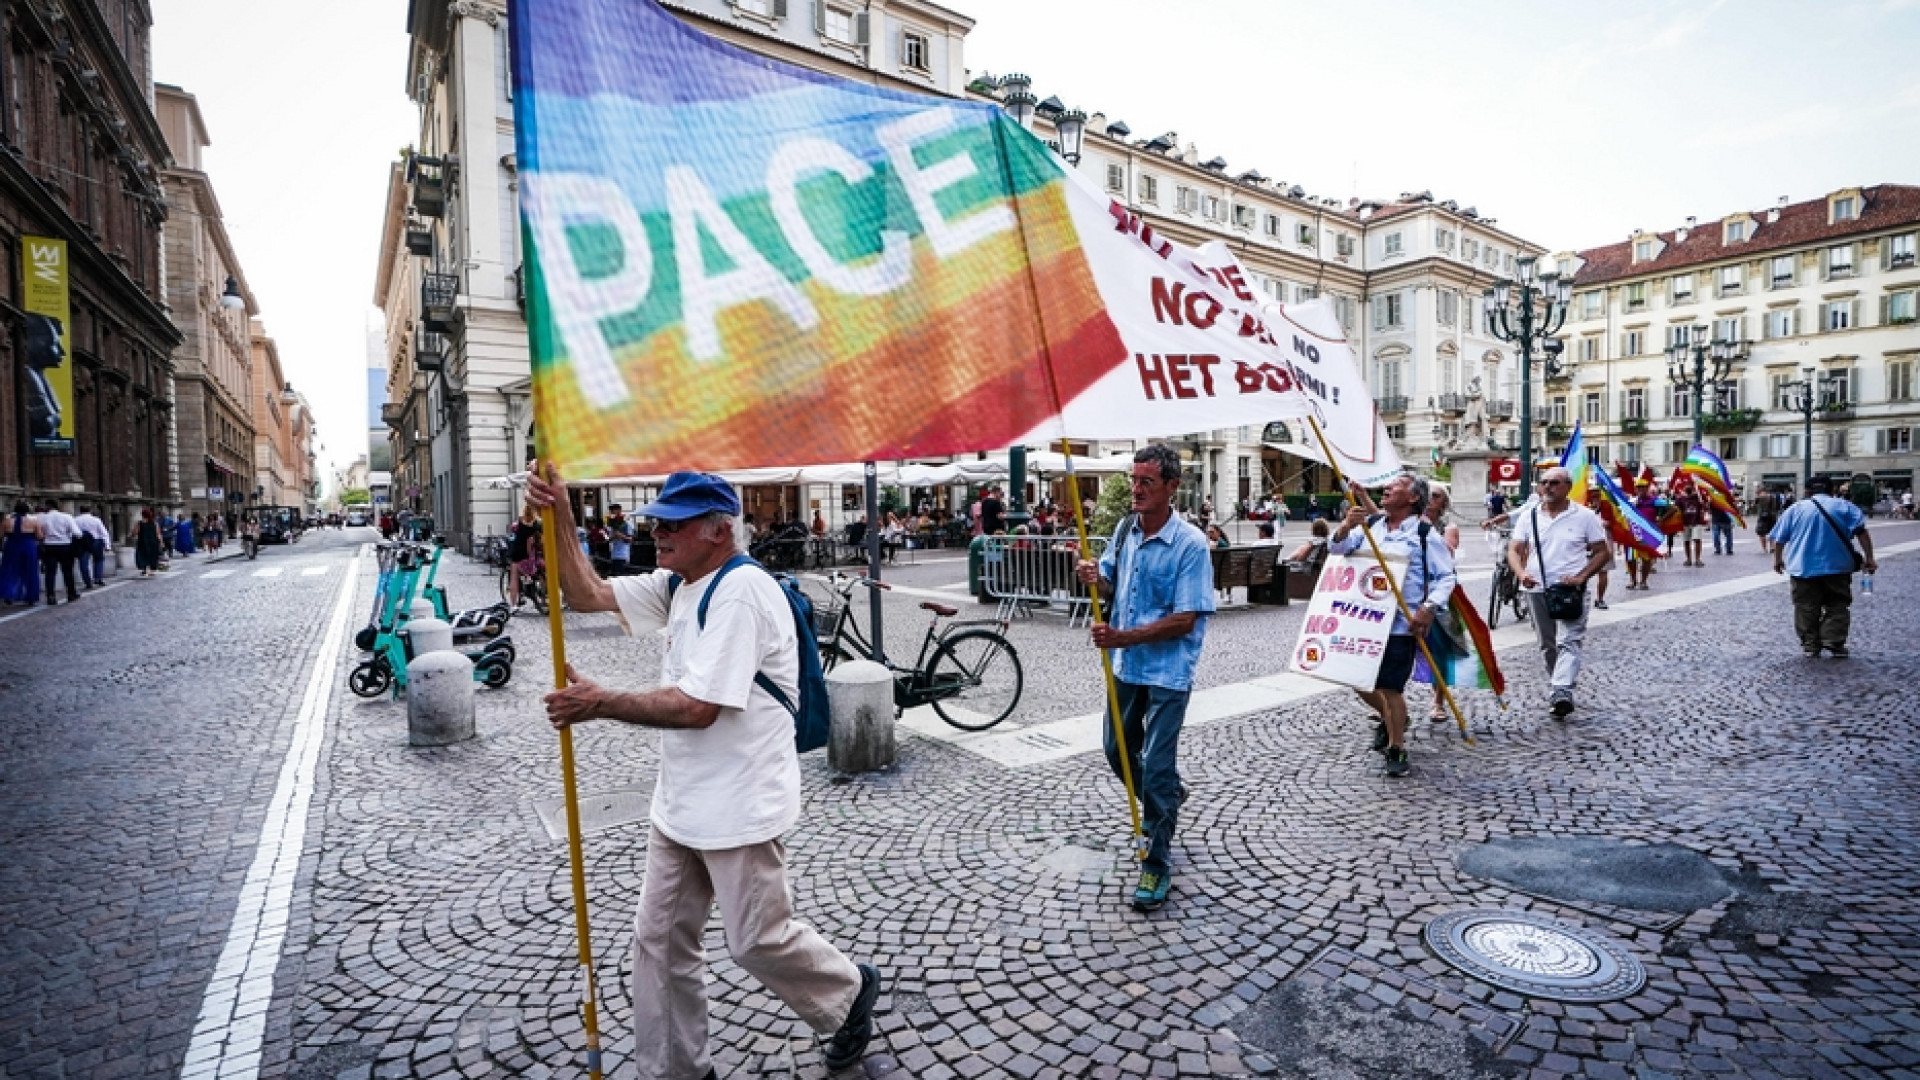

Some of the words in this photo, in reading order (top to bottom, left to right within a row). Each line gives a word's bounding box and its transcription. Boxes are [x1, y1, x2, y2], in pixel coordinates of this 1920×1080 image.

[522, 107, 1016, 410] PACE
[1151, 276, 1224, 329] NO
[1293, 335, 1320, 364] NO
[1136, 354, 1220, 400] HET
[1305, 615, 1339, 635] NO
